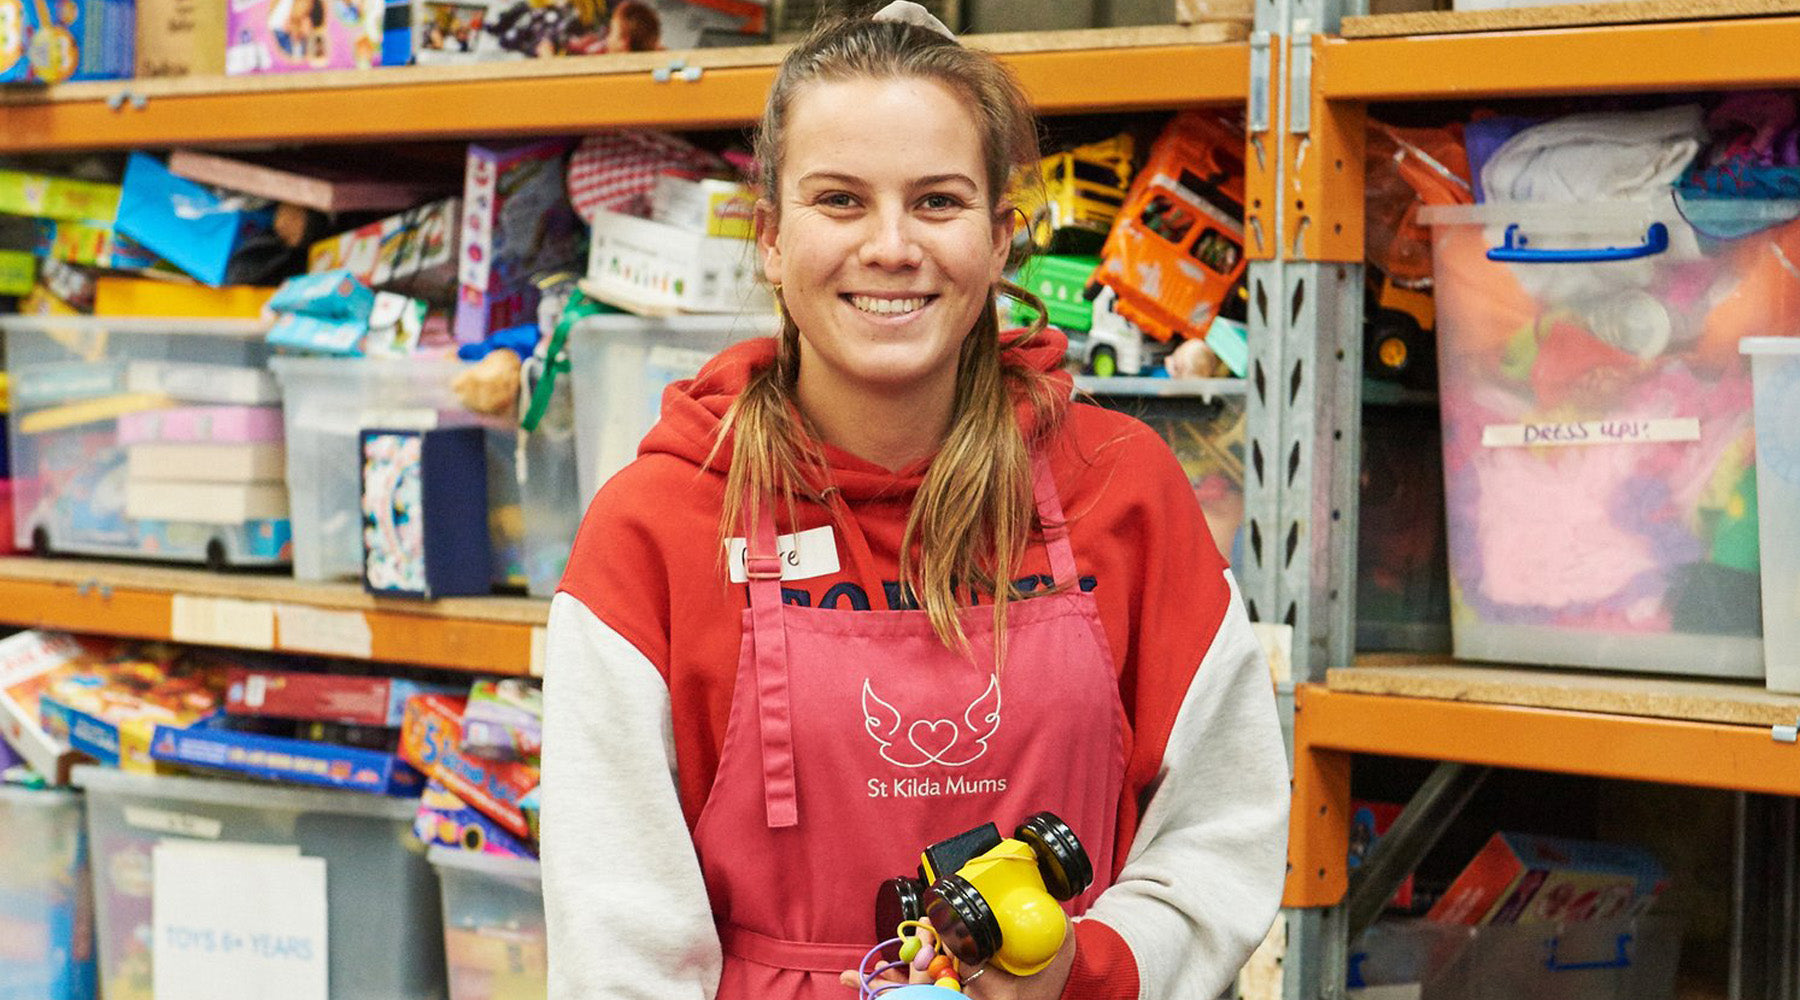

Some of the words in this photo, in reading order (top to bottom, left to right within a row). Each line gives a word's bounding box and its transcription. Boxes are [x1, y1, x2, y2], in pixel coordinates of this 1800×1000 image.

[867, 778, 888, 797] St
[894, 777, 941, 797] Kilda
[945, 775, 1007, 795] Mums
[165, 924, 217, 953] TOYS
[250, 932, 315, 961] YEARS
